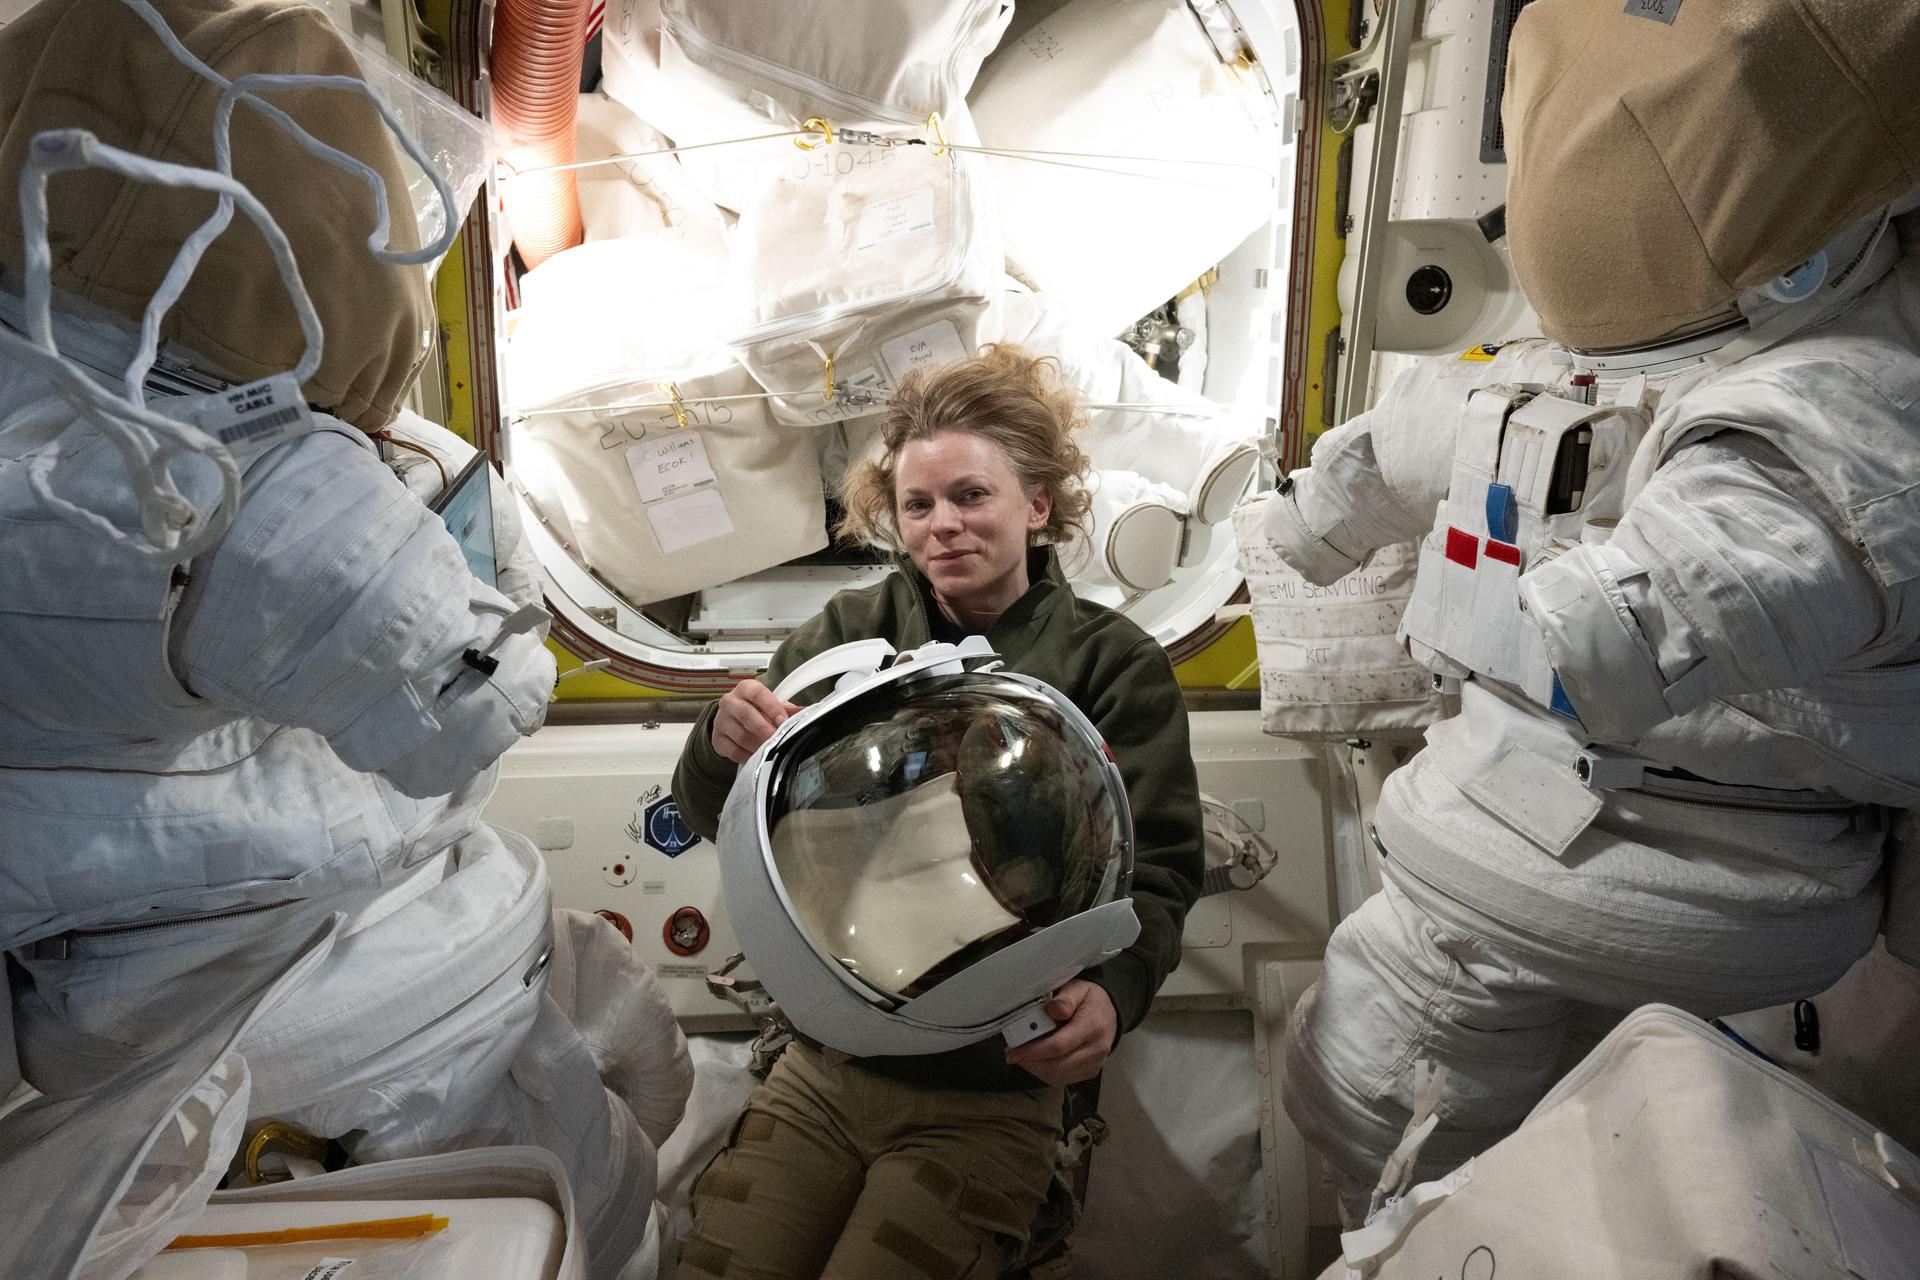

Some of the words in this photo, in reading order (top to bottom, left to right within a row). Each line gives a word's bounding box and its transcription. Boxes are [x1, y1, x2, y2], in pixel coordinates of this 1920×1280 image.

[235, 396, 273, 414] CABLE
[657, 438, 695, 457] Williams
[1269, 582, 1296, 599] EMU
[1303, 576, 1386, 598] SERVICING
